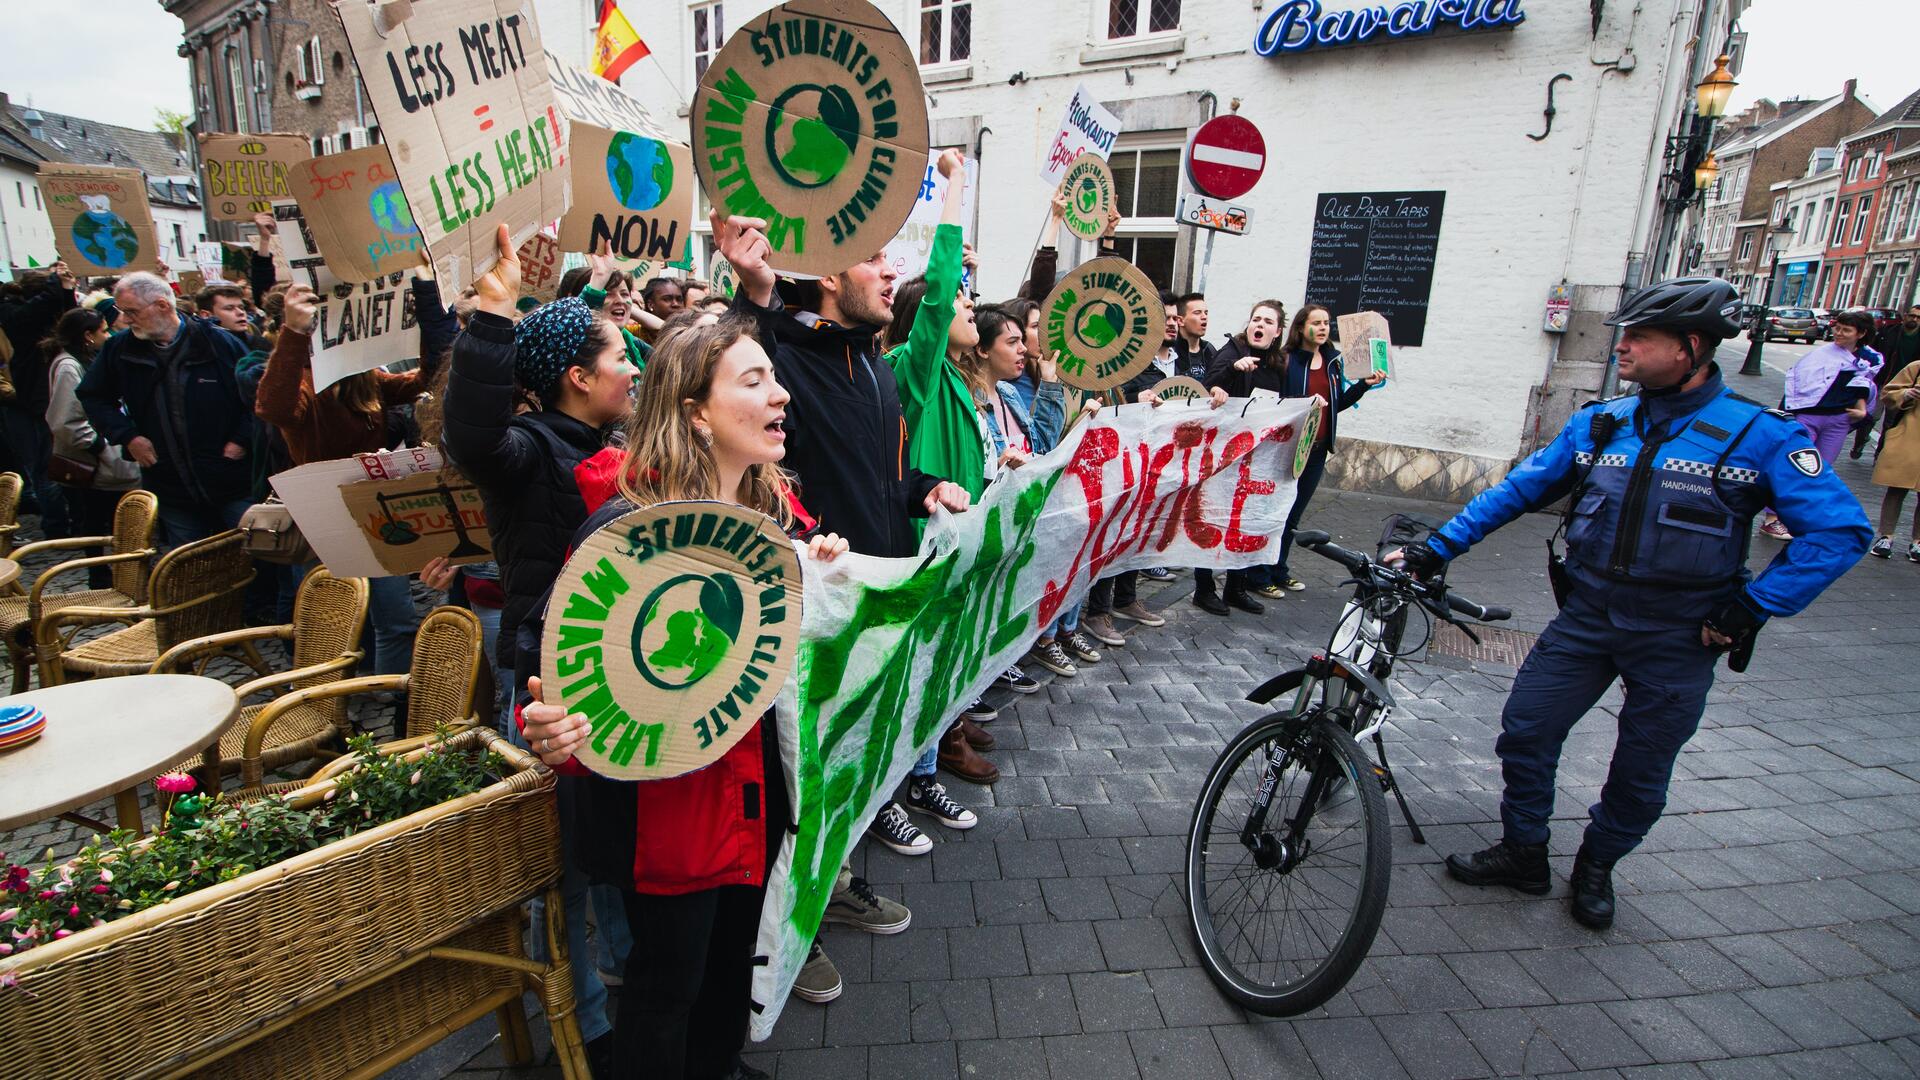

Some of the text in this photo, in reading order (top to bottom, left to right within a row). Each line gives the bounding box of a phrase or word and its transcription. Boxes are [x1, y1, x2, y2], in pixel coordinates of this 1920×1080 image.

[386, 14, 527, 113] LESS MEAT
[751, 19, 899, 245] STUDENTS FOR CLIMATE
[310, 160, 394, 199] for a
[429, 151, 495, 233] LESS
[1064, 162, 1089, 197] STUDENTS
[1353, 196, 1390, 218] PASA
[1395, 197, 1430, 217] TAPAS
[589, 213, 678, 259] NOW
[1082, 272, 1148, 379] STUDENTS FOR CLIMATE
[1661, 479, 1712, 496] HANDHAVING
[626, 513, 787, 750] STUDENTS FOR CLIMATE
